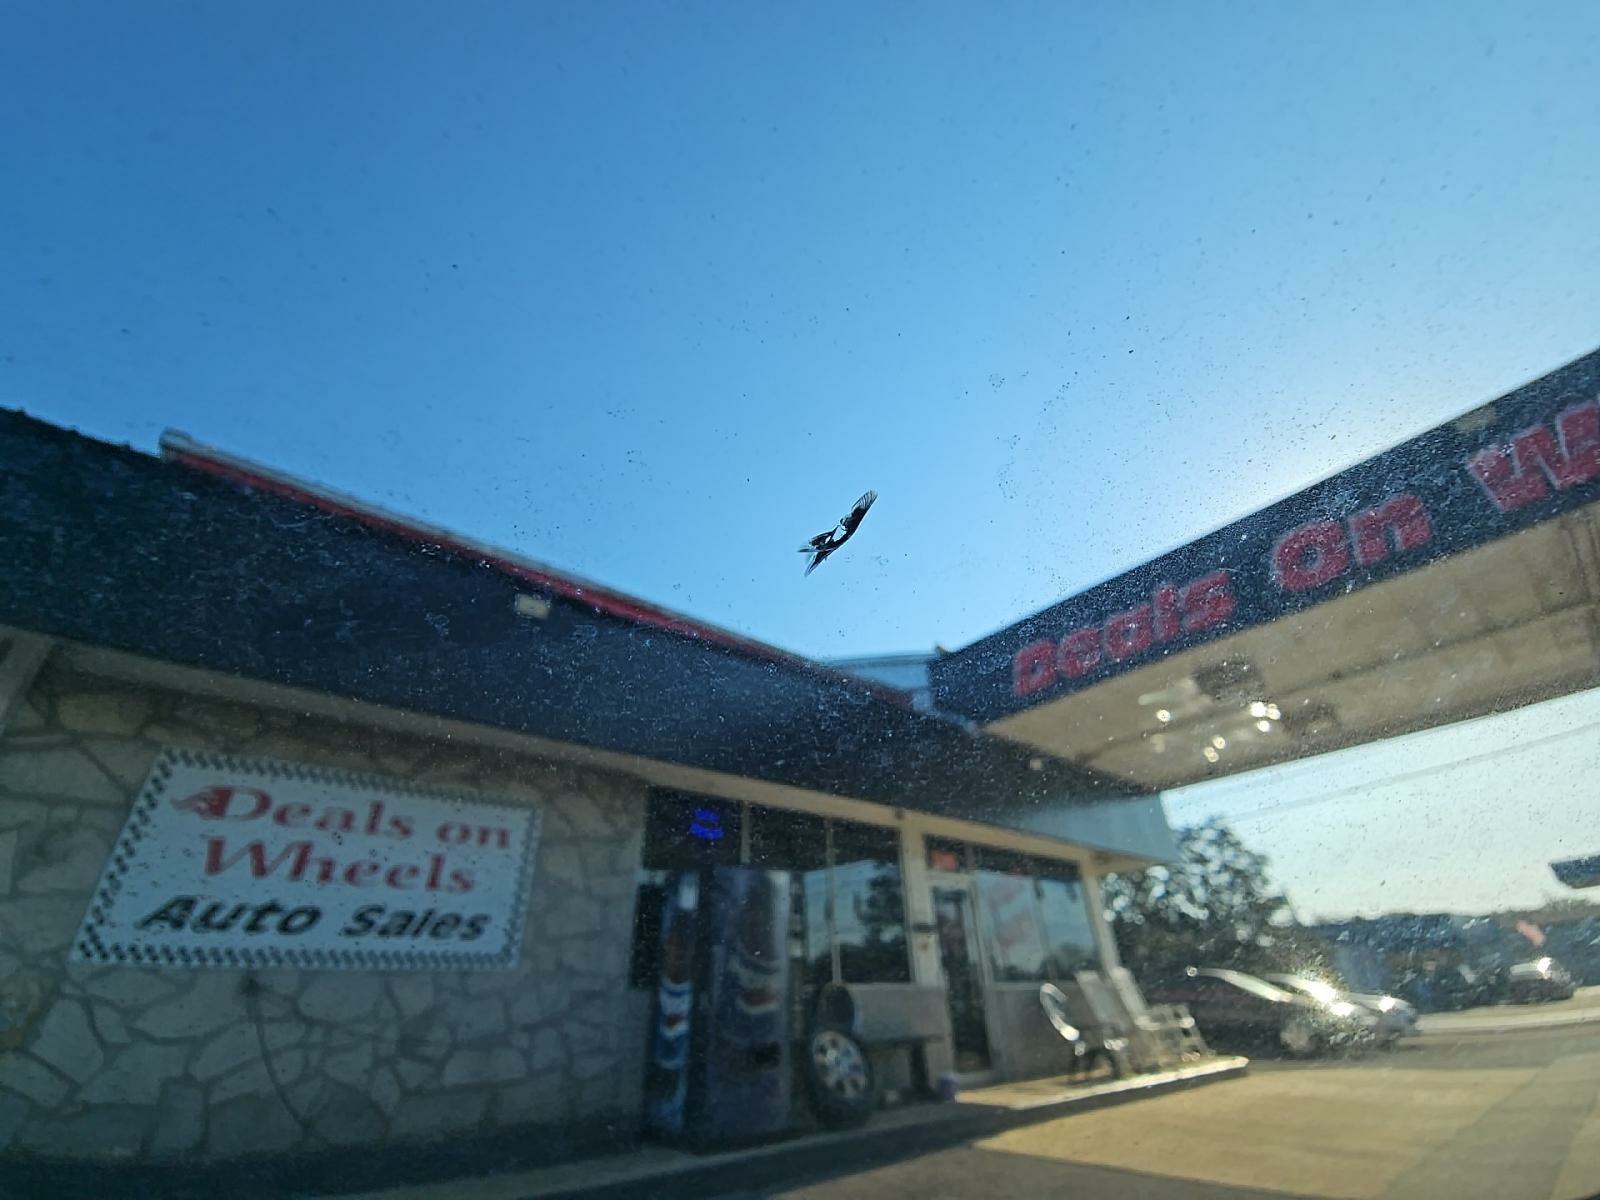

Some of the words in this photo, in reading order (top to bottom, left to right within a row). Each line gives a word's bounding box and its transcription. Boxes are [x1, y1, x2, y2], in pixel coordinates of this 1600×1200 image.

[1272, 493, 1433, 594] on
[1466, 400, 1600, 513] W
[196, 784, 414, 840] Deals
[435, 821, 512, 850] on
[202, 835, 476, 894] Wheels
[135, 894, 322, 936] Auto
[342, 903, 494, 942] Sales
